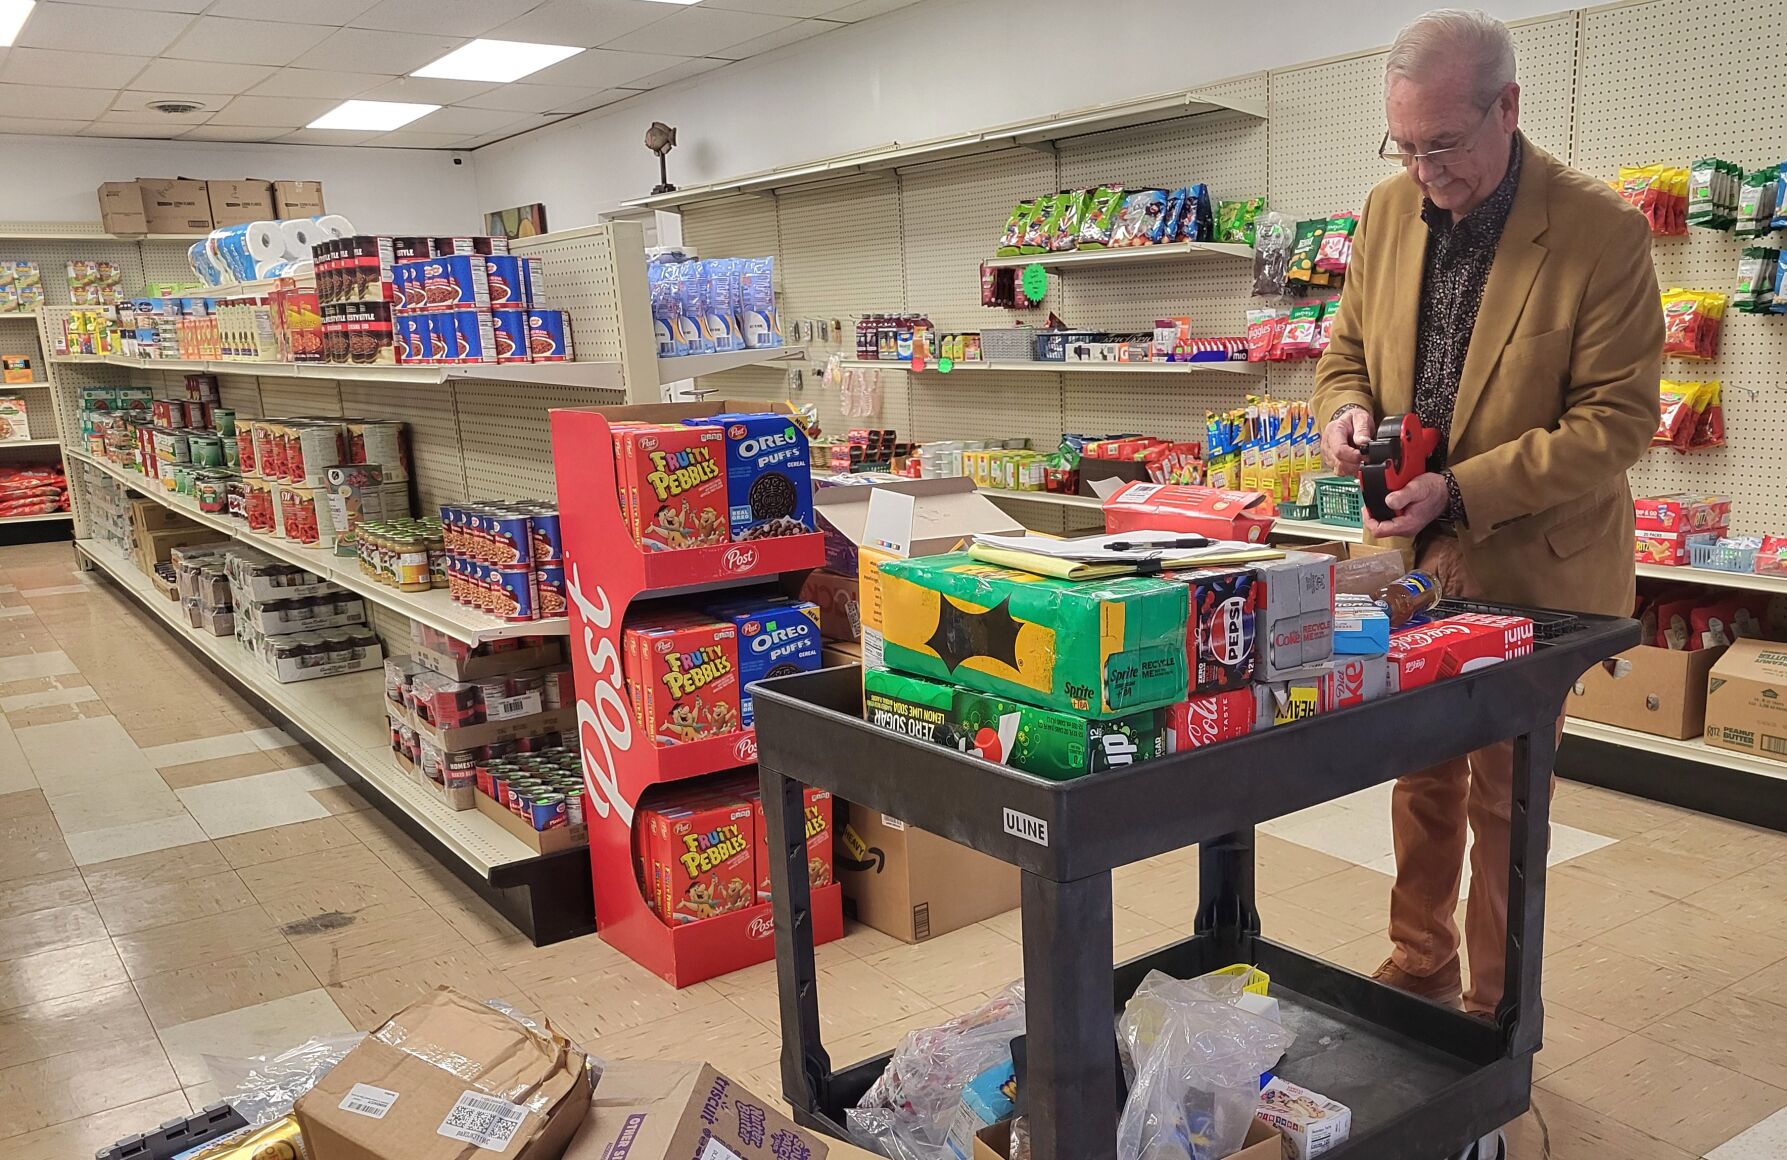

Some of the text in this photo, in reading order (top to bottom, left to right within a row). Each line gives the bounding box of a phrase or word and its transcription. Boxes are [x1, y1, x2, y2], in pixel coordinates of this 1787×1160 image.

[1233, 352, 1246, 360] mio
[730, 427, 744, 438] Post
[795, 418, 807, 431] NEW
[641, 438, 656, 449] Post
[739, 433, 796, 458] OREO
[757, 448, 800, 468] PUFFS
[787, 460, 806, 468] CEREAL
[647, 459, 719, 501] PEBBLES
[1636, 541, 1649, 551] RITZ
[728, 549, 754, 569] Post
[807, 610, 819, 622] NEW
[744, 624, 758, 634] Post
[1228, 600, 1240, 661] PEPSI
[1303, 621, 1331, 633] RECYCLE
[752, 624, 808, 652] OREO
[1276, 630, 1300, 647] Coke
[1303, 633, 1313, 641] ME
[1504, 623, 1534, 649] mini
[657, 641, 672, 652] Post
[771, 640, 811, 660] PUFFS
[799, 650, 816, 658] CEREAL
[1142, 658, 1175, 670] RECYCLE
[663, 656, 731, 700] PEBBLES
[1110, 666, 1138, 683] Sprite
[1142, 670, 1153, 679] ME
[1065, 682, 1094, 699] Sprite
[1336, 670, 1345, 697] Diet
[566, 561, 634, 827] Post
[894, 701, 908, 715] SODA
[909, 705, 923, 718] LIME
[874, 709, 934, 742] ZERO SUGAR
[924, 710, 944, 725] LEMON
[1090, 729, 1098, 740] 12
[1707, 726, 1720, 737] RITZ
[1723, 732, 1753, 743] BUTTER
[1724, 727, 1754, 737] PEANUT
[740, 739, 757, 758] Pos
[676, 823, 689, 833] Post
[1007, 813, 1045, 840] ULINE
[845, 830, 864, 855] HEAVY
[680, 834, 746, 878] PEBBLES
[751, 914, 774, 936] Post
[700, 1076, 730, 1125] triscuit
[735, 1100, 750, 1145] Butter
[749, 1104, 765, 1148] Nutter
[618, 1117, 641, 1148] OTHER
[792, 1137, 805, 1160] SOU
